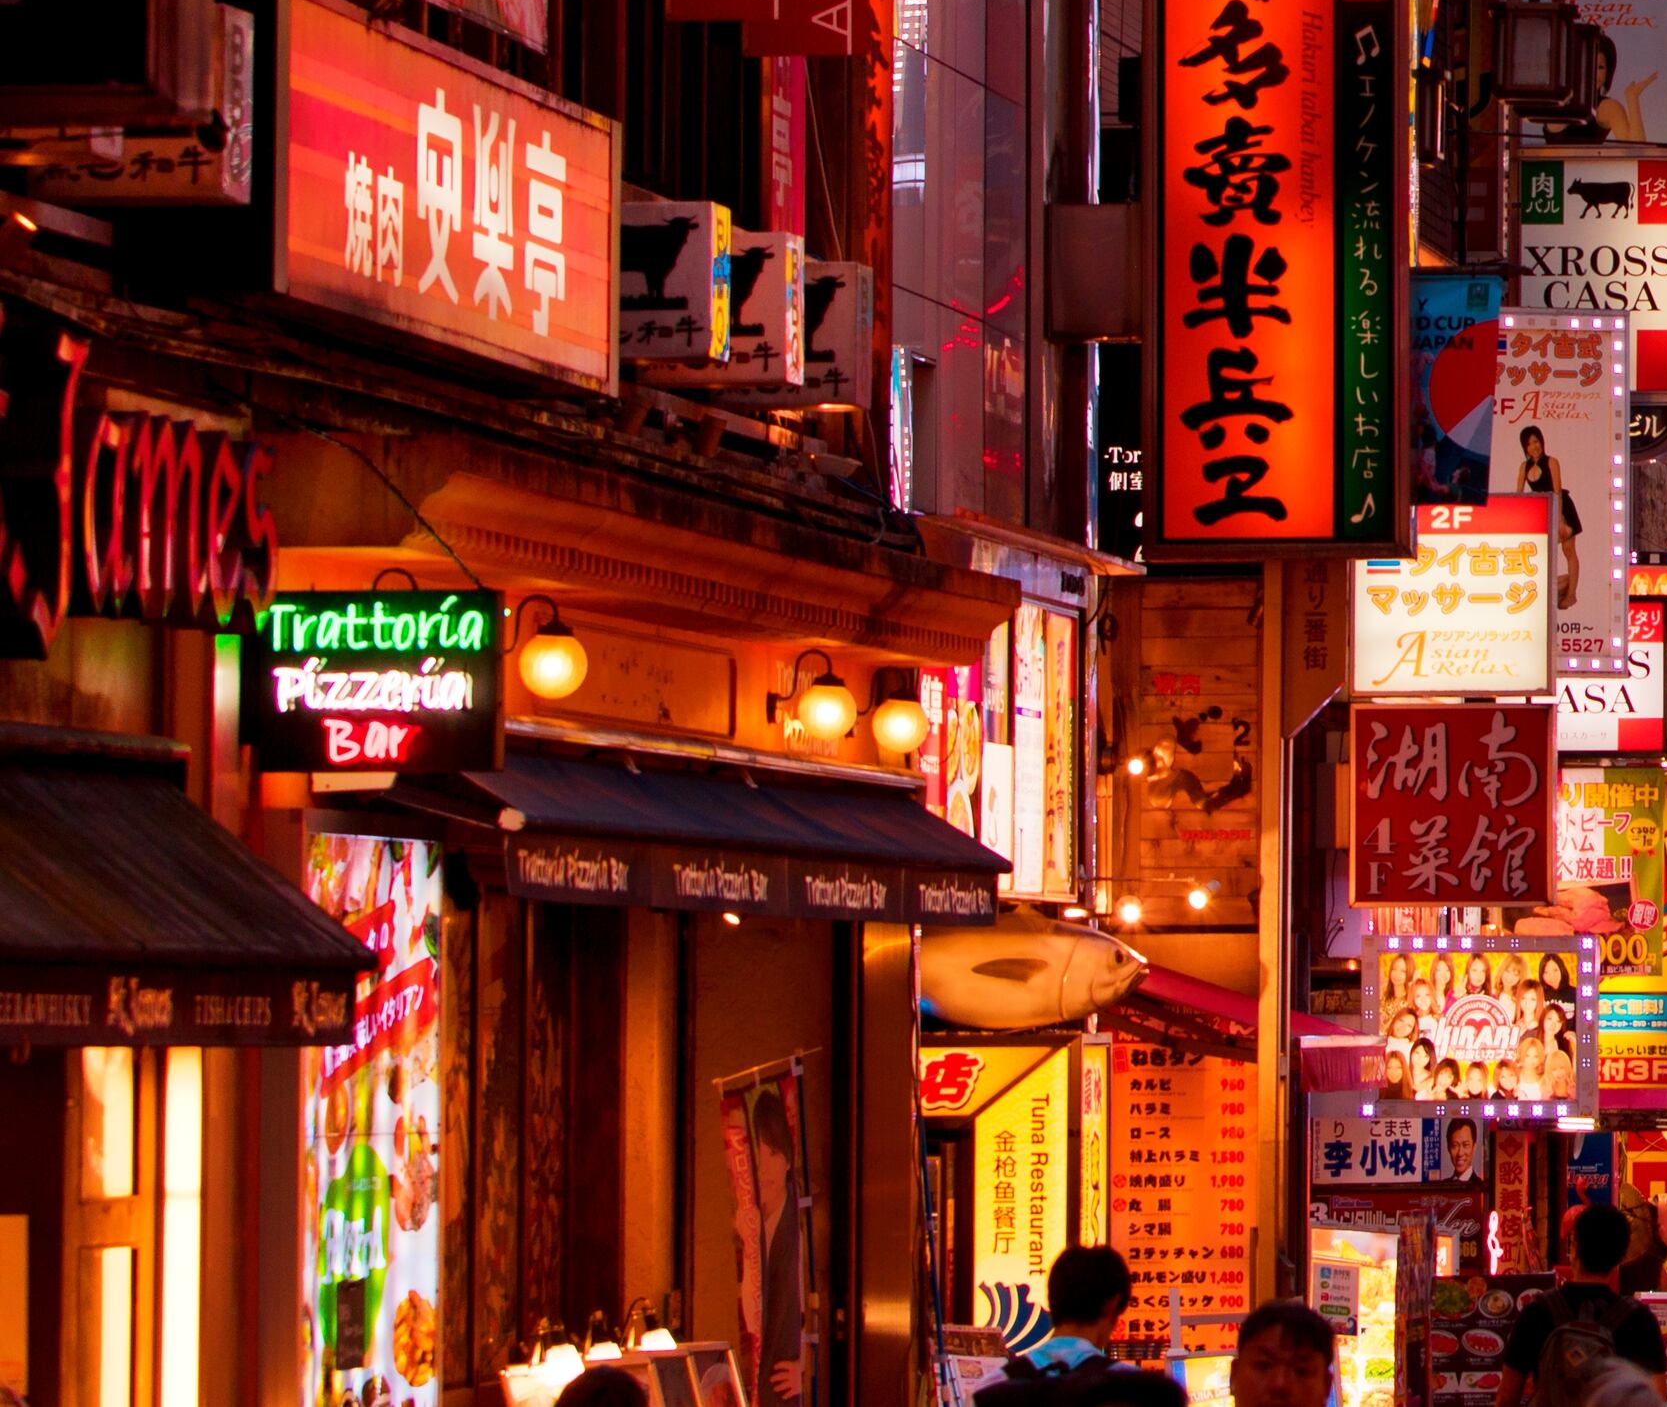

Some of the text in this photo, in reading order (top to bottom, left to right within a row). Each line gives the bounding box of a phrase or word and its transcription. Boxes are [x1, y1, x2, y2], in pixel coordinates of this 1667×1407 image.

[1530, 173, 1555, 198] 肉
[1542, 280, 1661, 314] CASA
[1511, 334, 1603, 359] タイ古式
[1431, 507, 1473, 530] 2F
[1409, 541, 1538, 576] タイ古式
[1366, 584, 1538, 616] マッサージ
[1431, 630, 1533, 642] アジアンリラックス
[1561, 639, 1604, 653] 5527
[1430, 661, 1521, 678] Relax
[322, 717, 413, 762] Bar
[1366, 711, 1540, 809] 湖南
[1028, 1094, 1050, 1277] Tuna Restaurant
